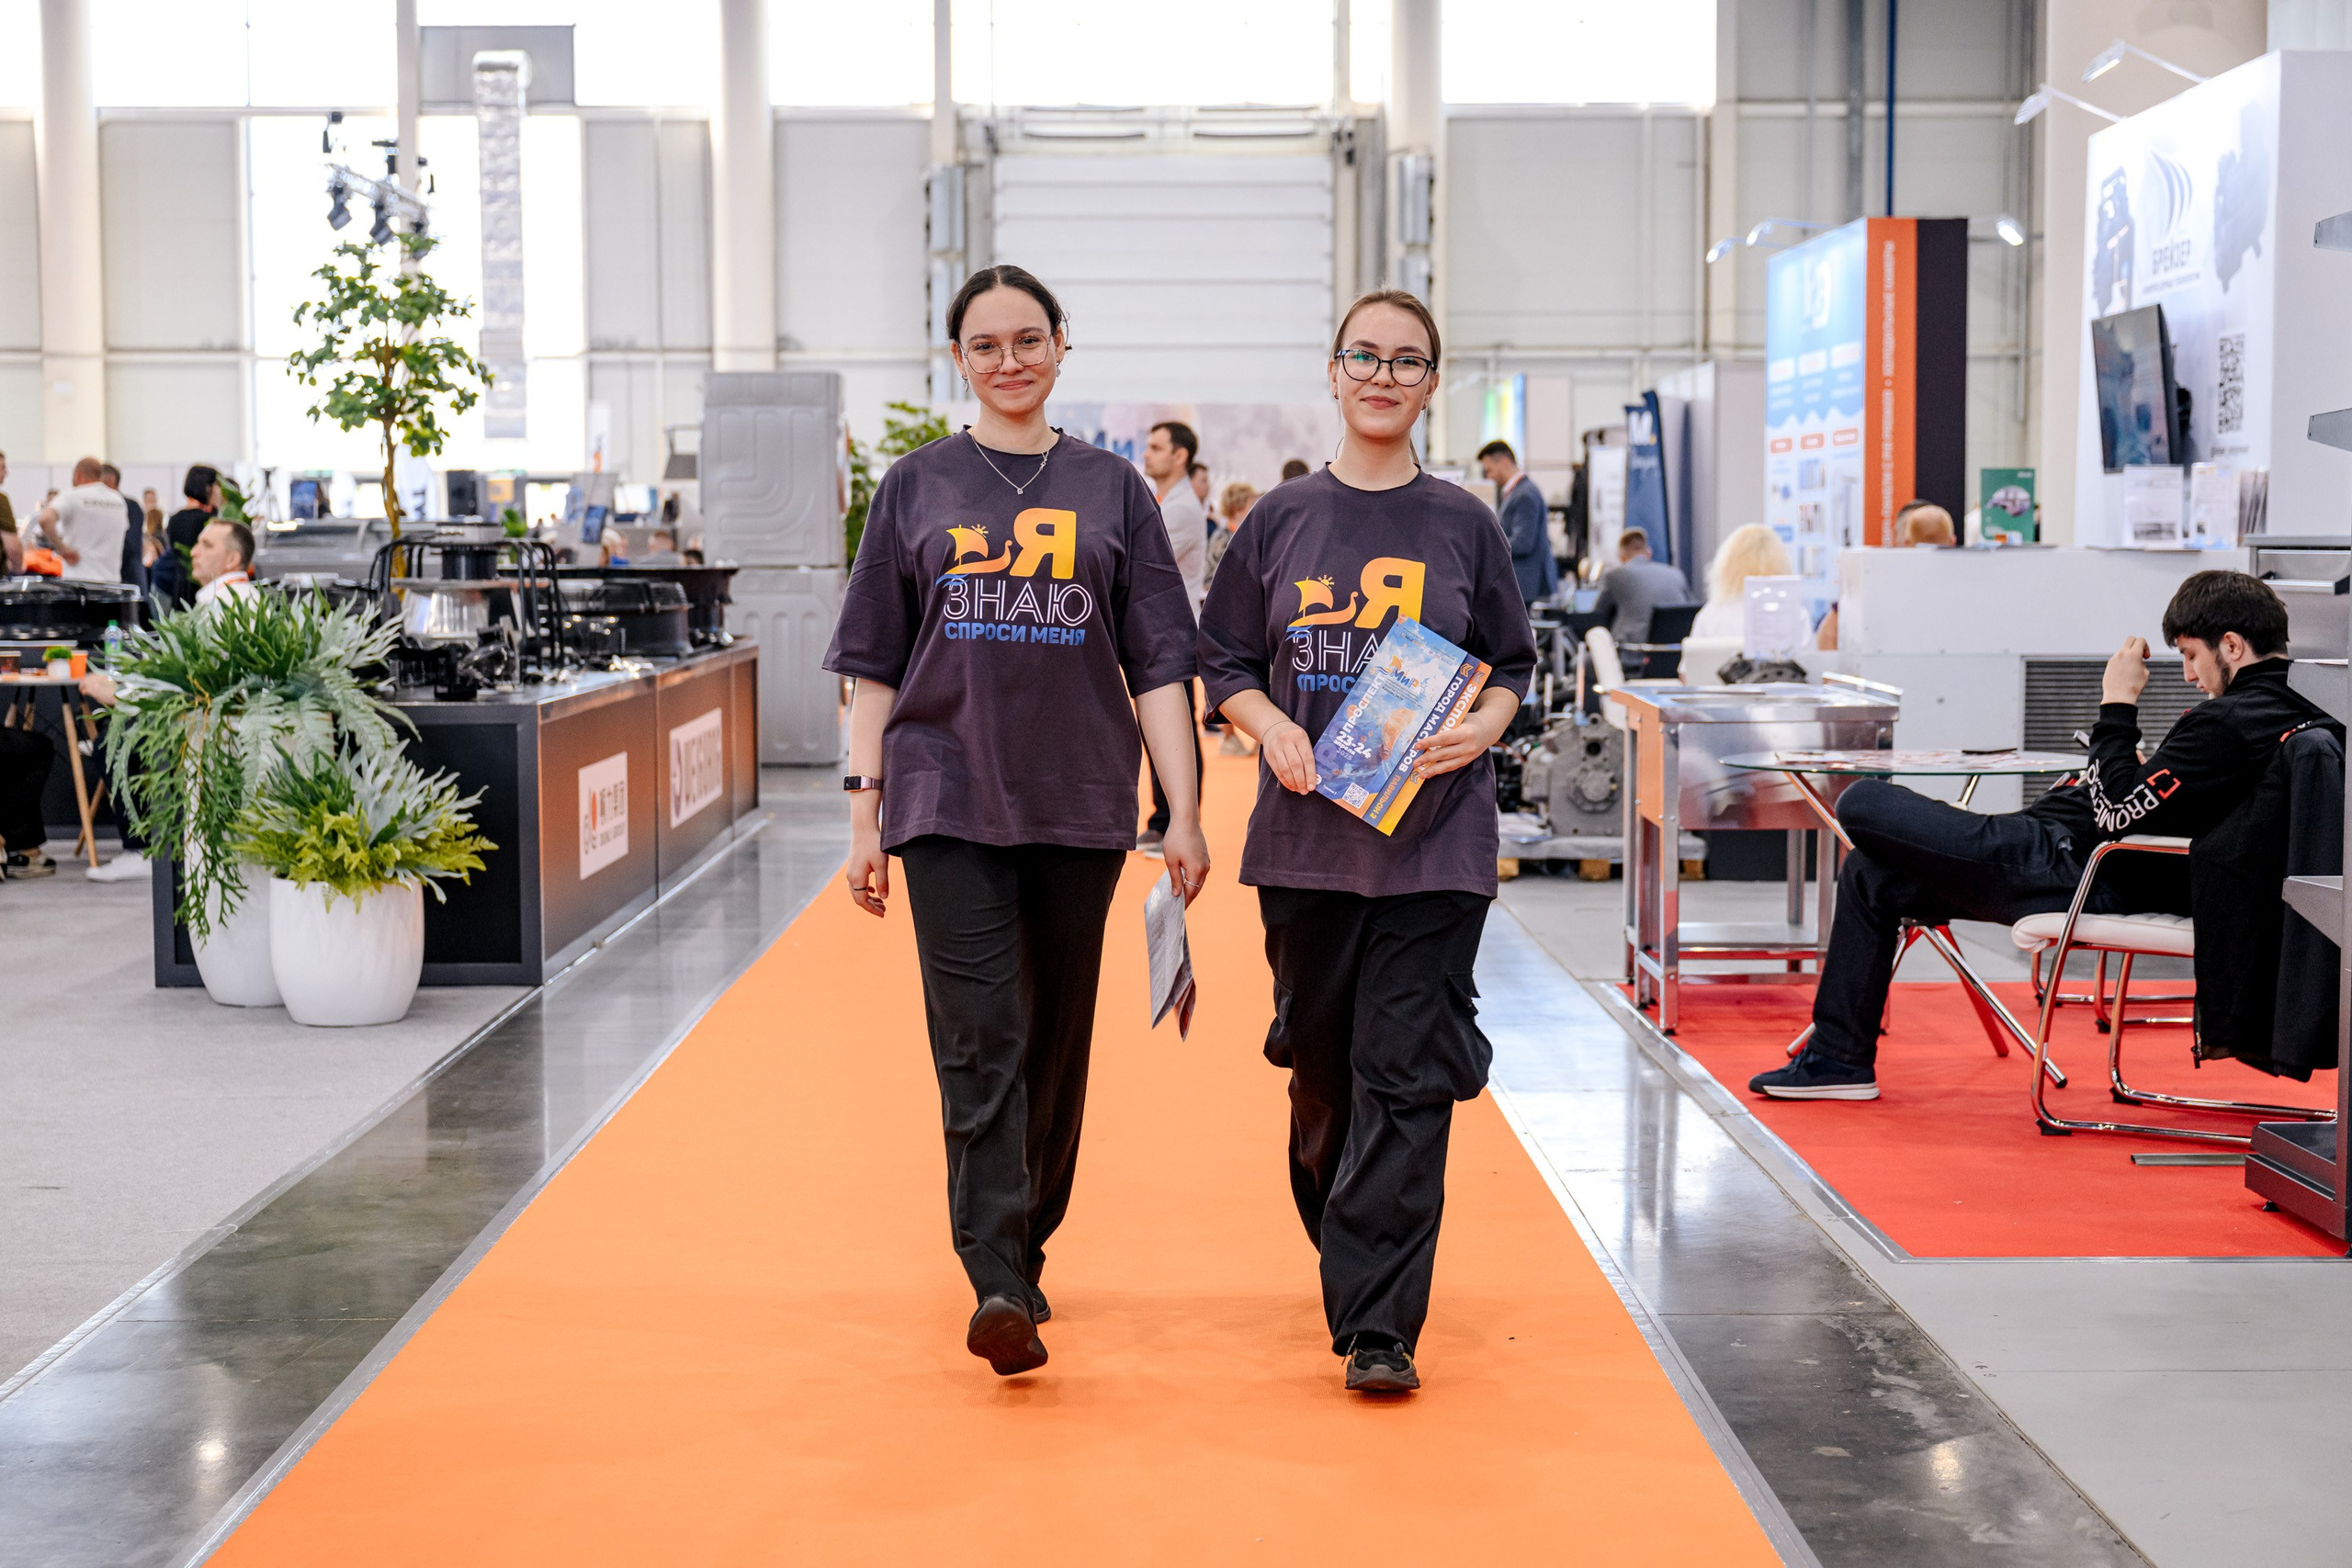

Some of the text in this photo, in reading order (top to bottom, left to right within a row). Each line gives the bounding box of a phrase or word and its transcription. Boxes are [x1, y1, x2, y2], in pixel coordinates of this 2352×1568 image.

[1009, 507, 1077, 580] Я
[943, 577, 1093, 627] ЗНАЮ
[1354, 557, 1426, 629] Я
[944, 622, 1086, 646] СПРОСИ МЕНЯ
[1292, 629, 1378, 673] ЗНА
[1296, 673, 1357, 694] СПРОС
[1434, 676, 1464, 714] ГОРОД
[1333, 739, 1356, 755] апреля
[1335, 730, 1372, 759] 23-24
[1336, 749, 1353, 761] 2025
[1398, 714, 1441, 773] МАСРОВ
[1373, 774, 1402, 816] ПАВИЛЬОН
